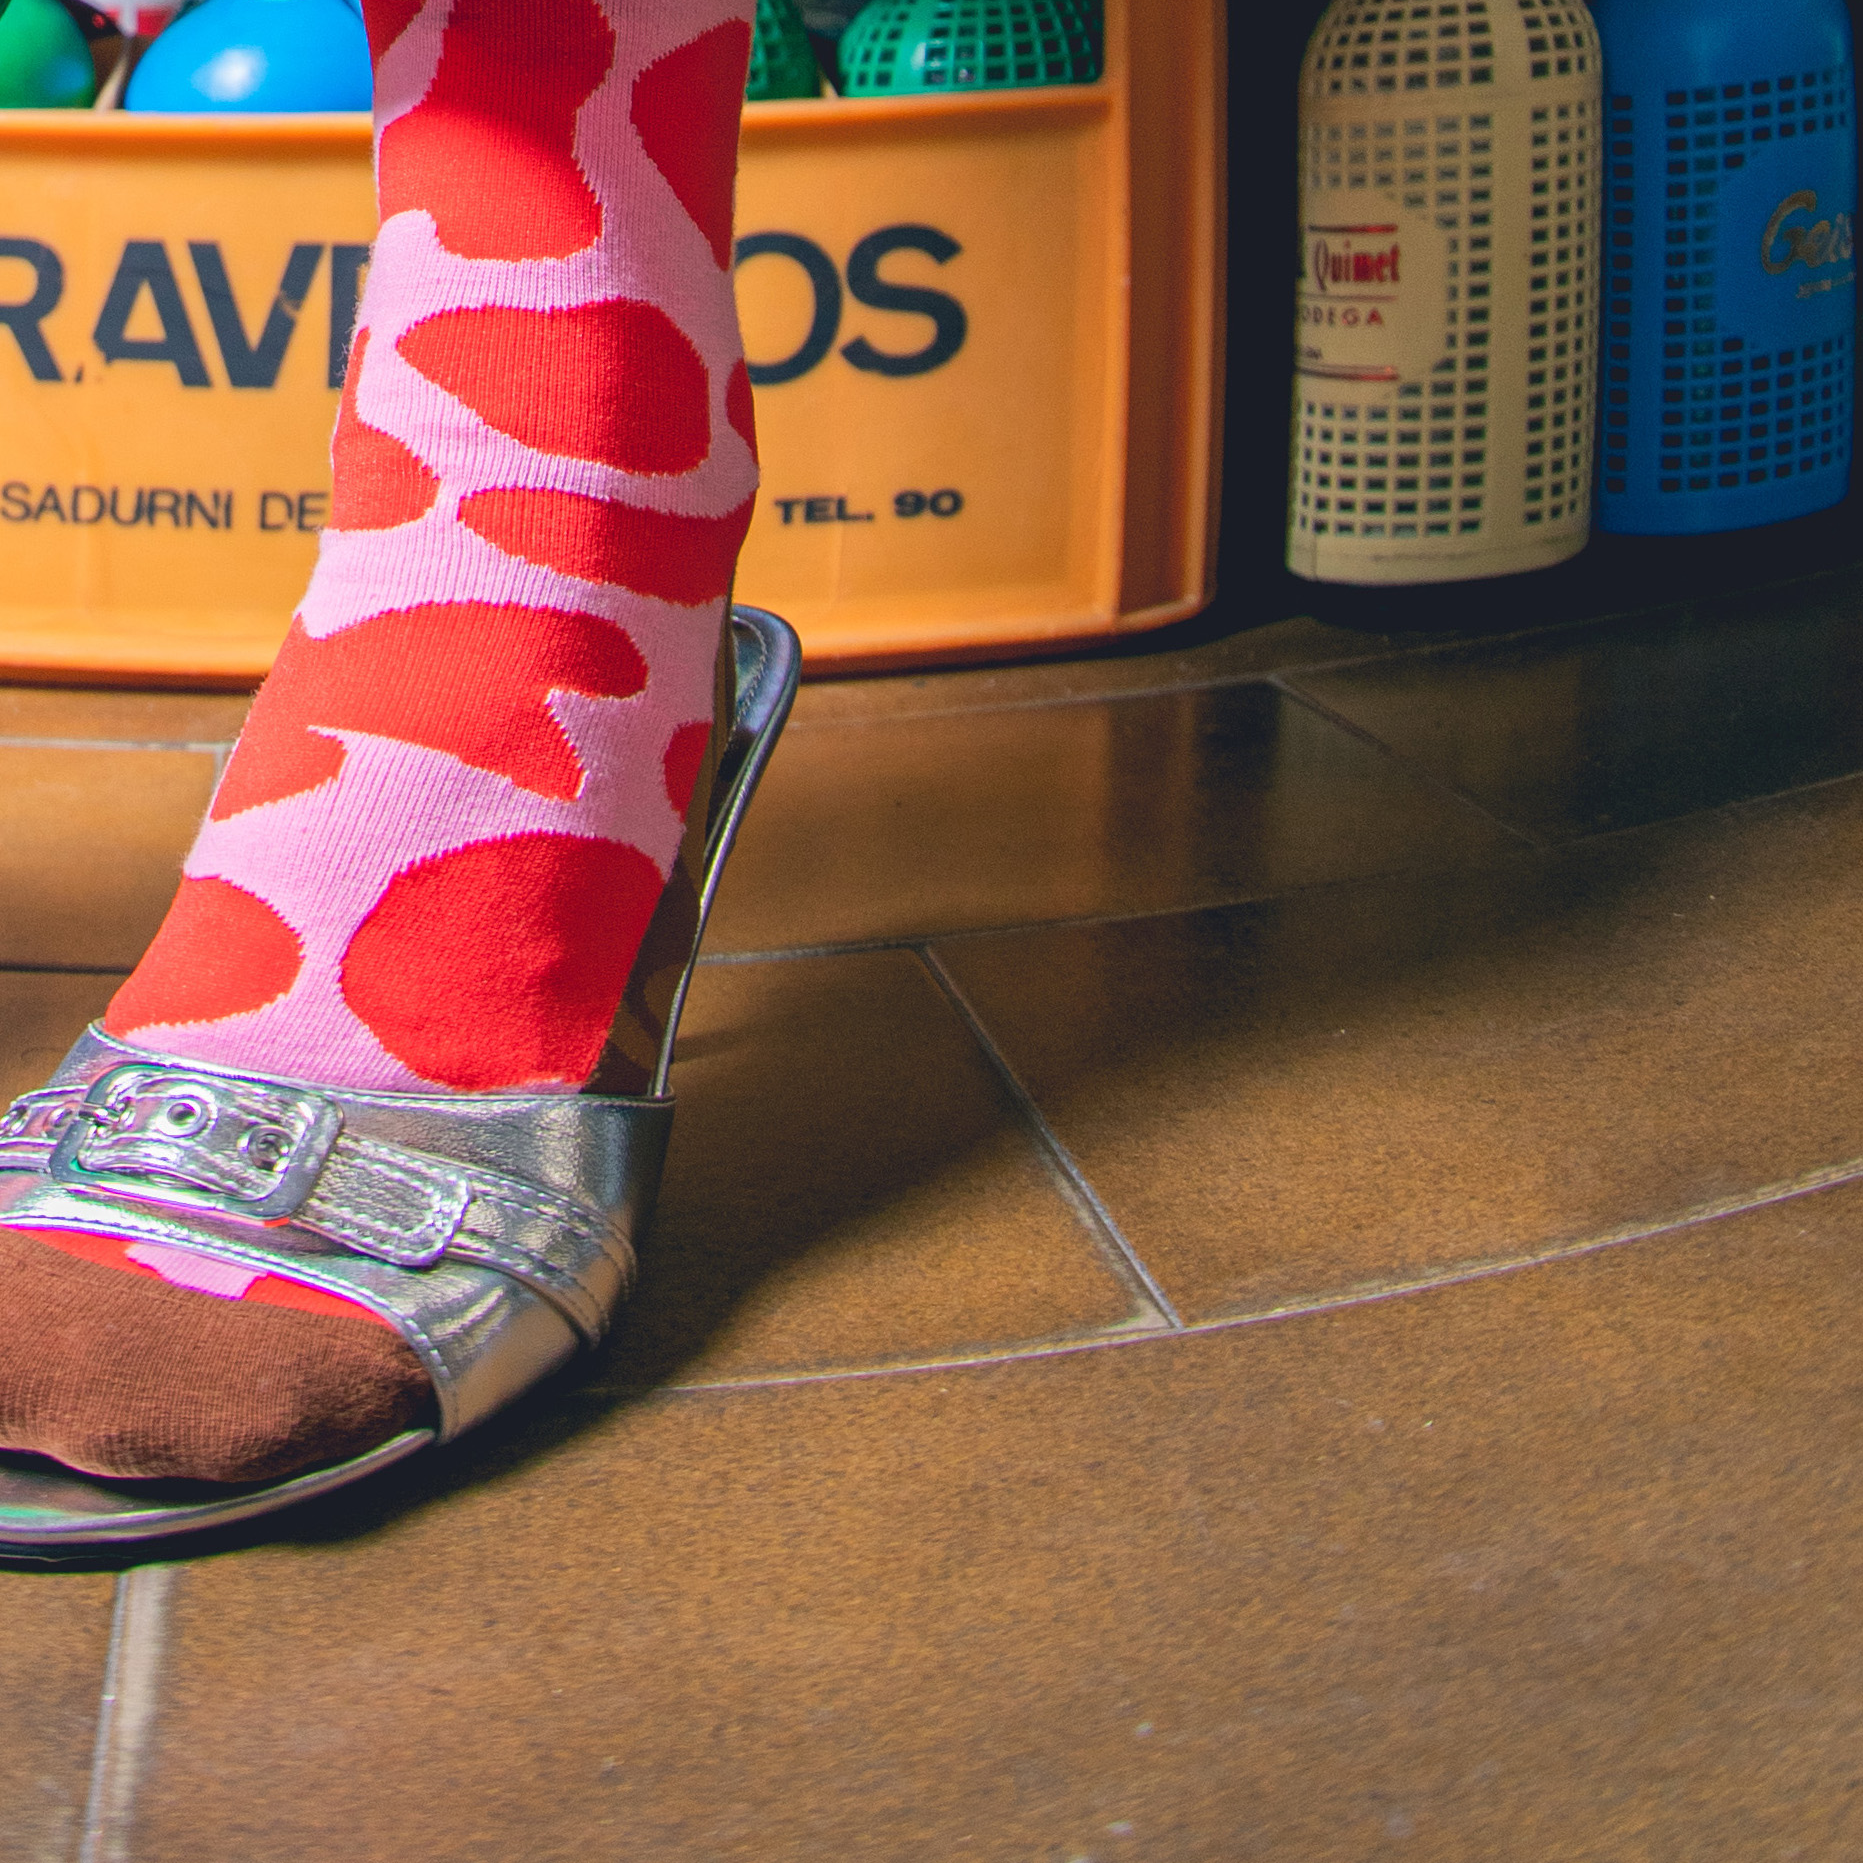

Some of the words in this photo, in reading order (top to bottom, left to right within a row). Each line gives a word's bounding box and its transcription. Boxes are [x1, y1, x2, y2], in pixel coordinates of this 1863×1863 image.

[1313, 238, 1402, 293] Quimet
[1300, 306, 1385, 328] ODEGA
[0, 481, 234, 531] SADURNI
[258, 489, 331, 533] DE
[775, 494, 875, 525] TEL.
[894, 488, 964, 519] 90
